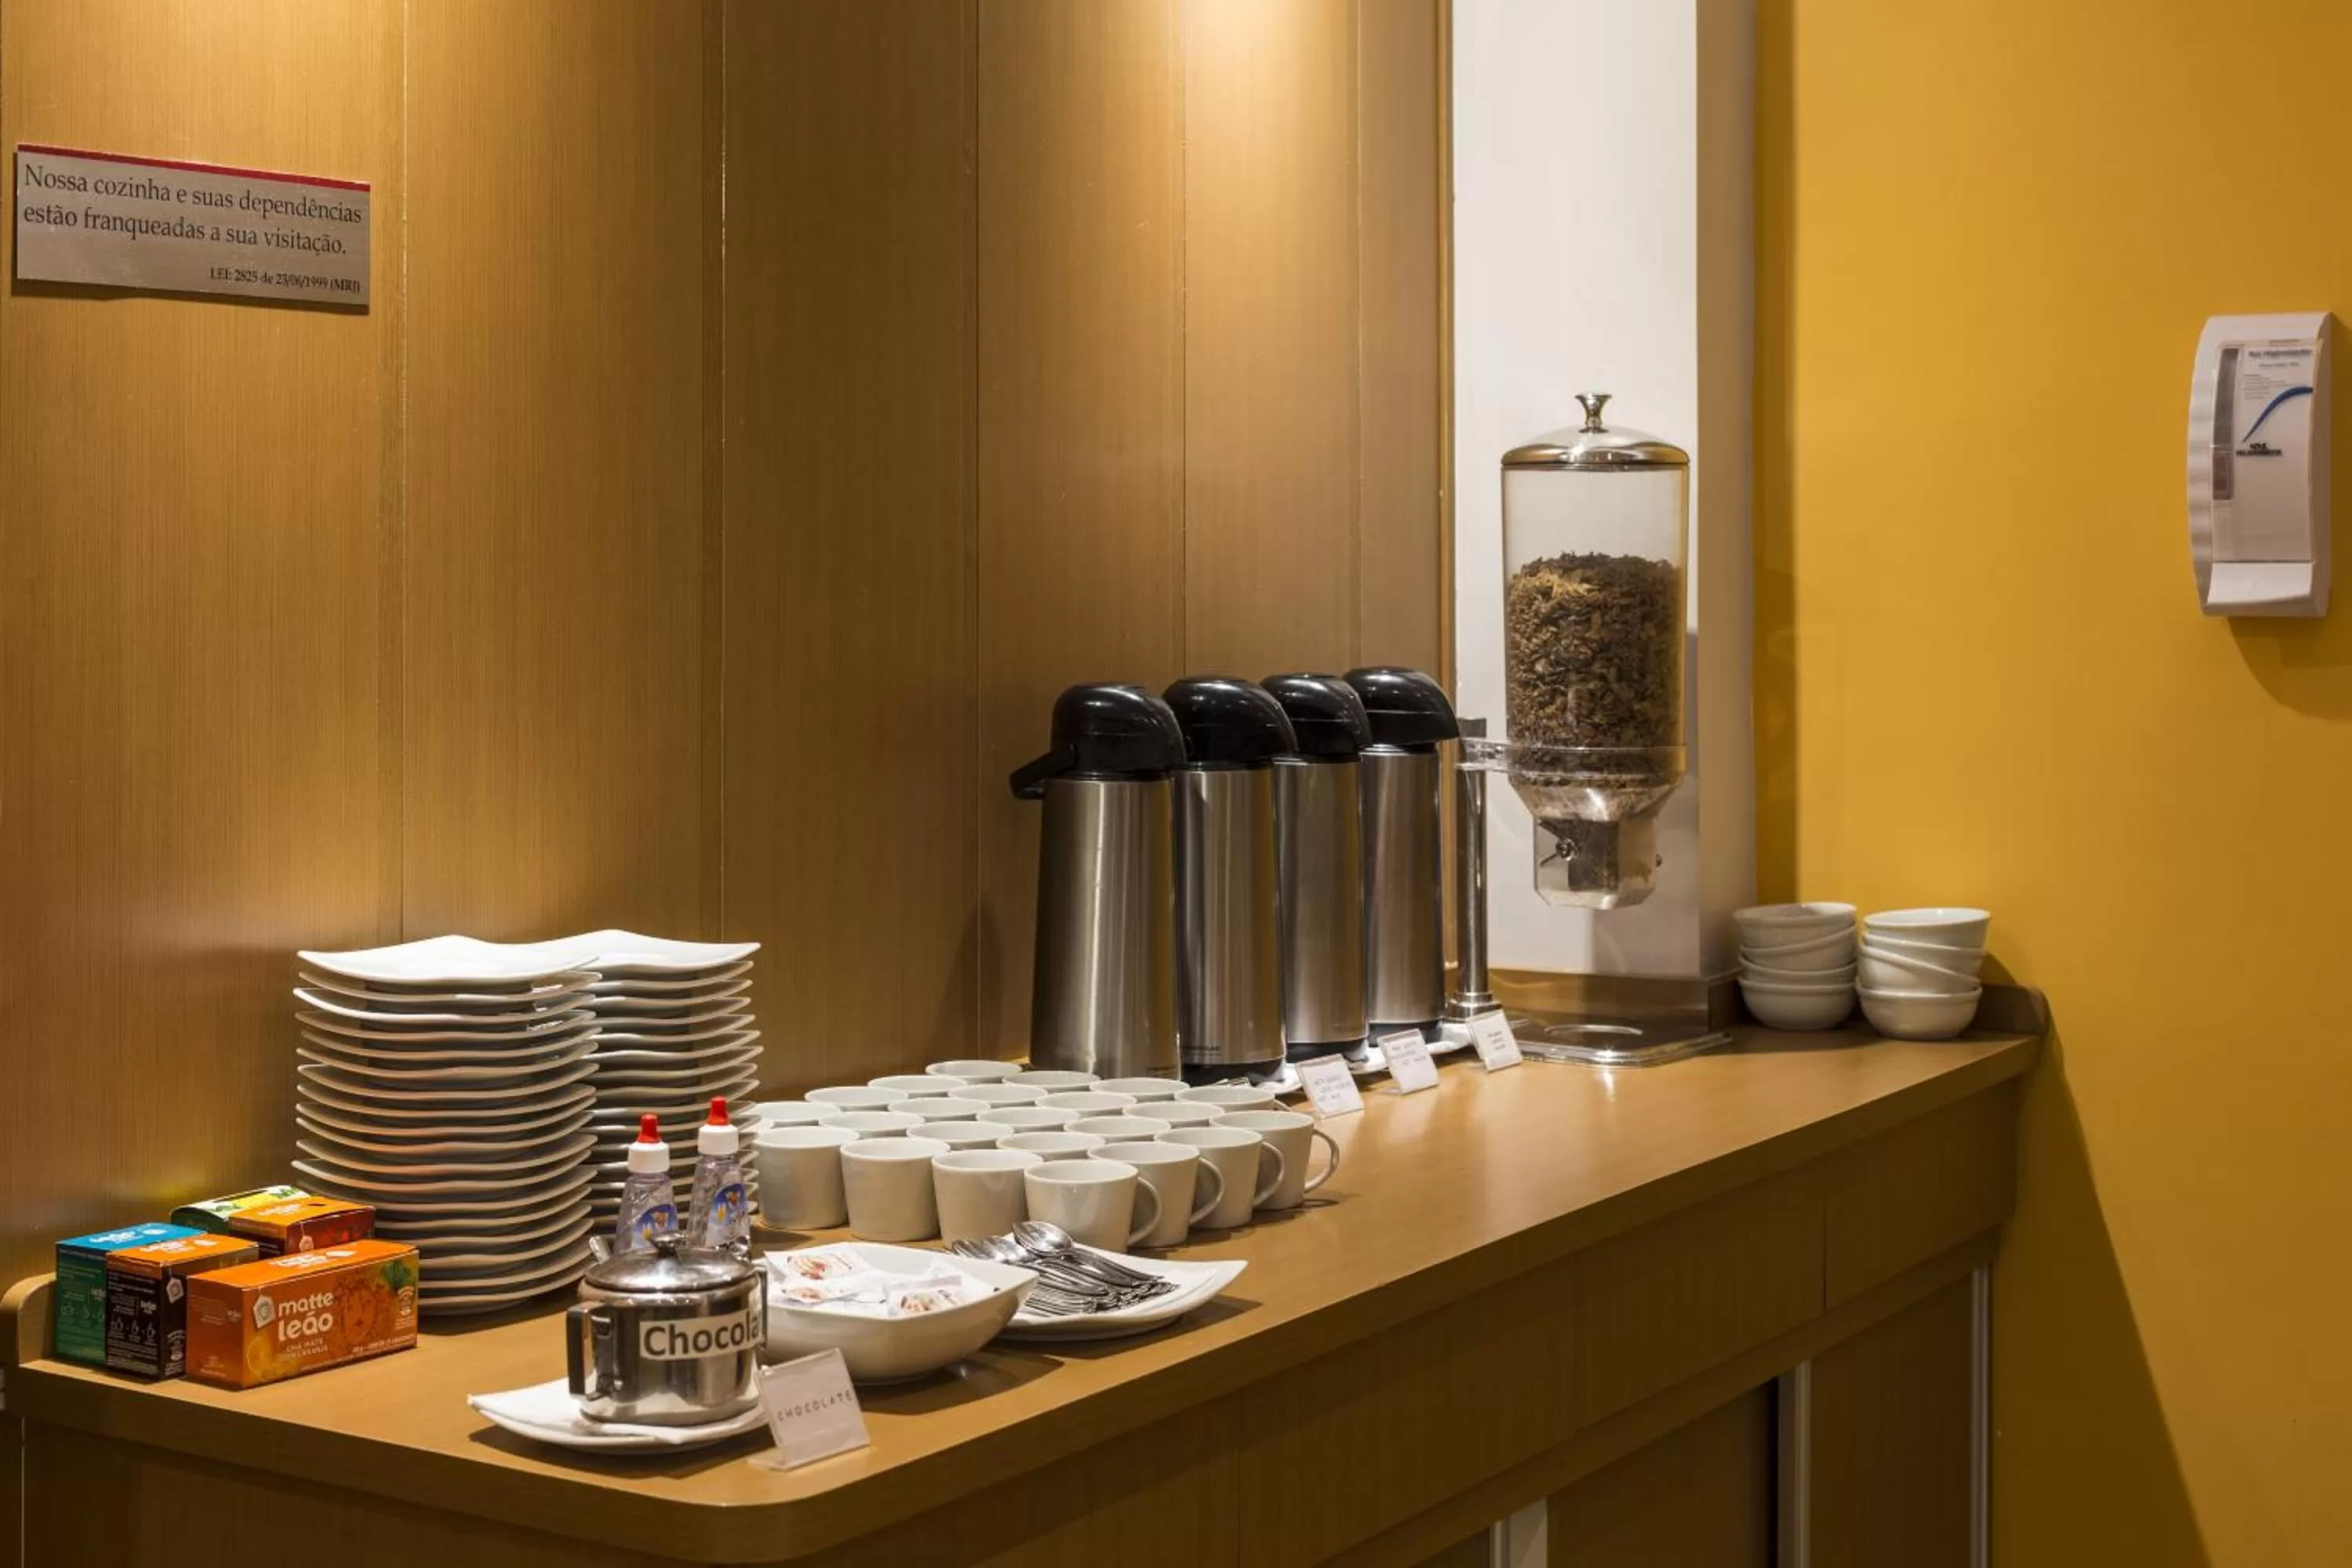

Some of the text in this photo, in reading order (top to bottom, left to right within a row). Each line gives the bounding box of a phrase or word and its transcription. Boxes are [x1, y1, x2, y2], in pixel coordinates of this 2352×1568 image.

[24, 163, 362, 223] Nossa cozinha e suas dependências
[24, 205, 347, 256] estão franqueadas a sua visitação.
[261, 270, 274, 285] de
[278, 1293, 333, 1317] matte
[278, 1311, 333, 1341] leão
[643, 1311, 760, 1357] Chocola
[777, 1388, 853, 1421] CHOCOLATE
